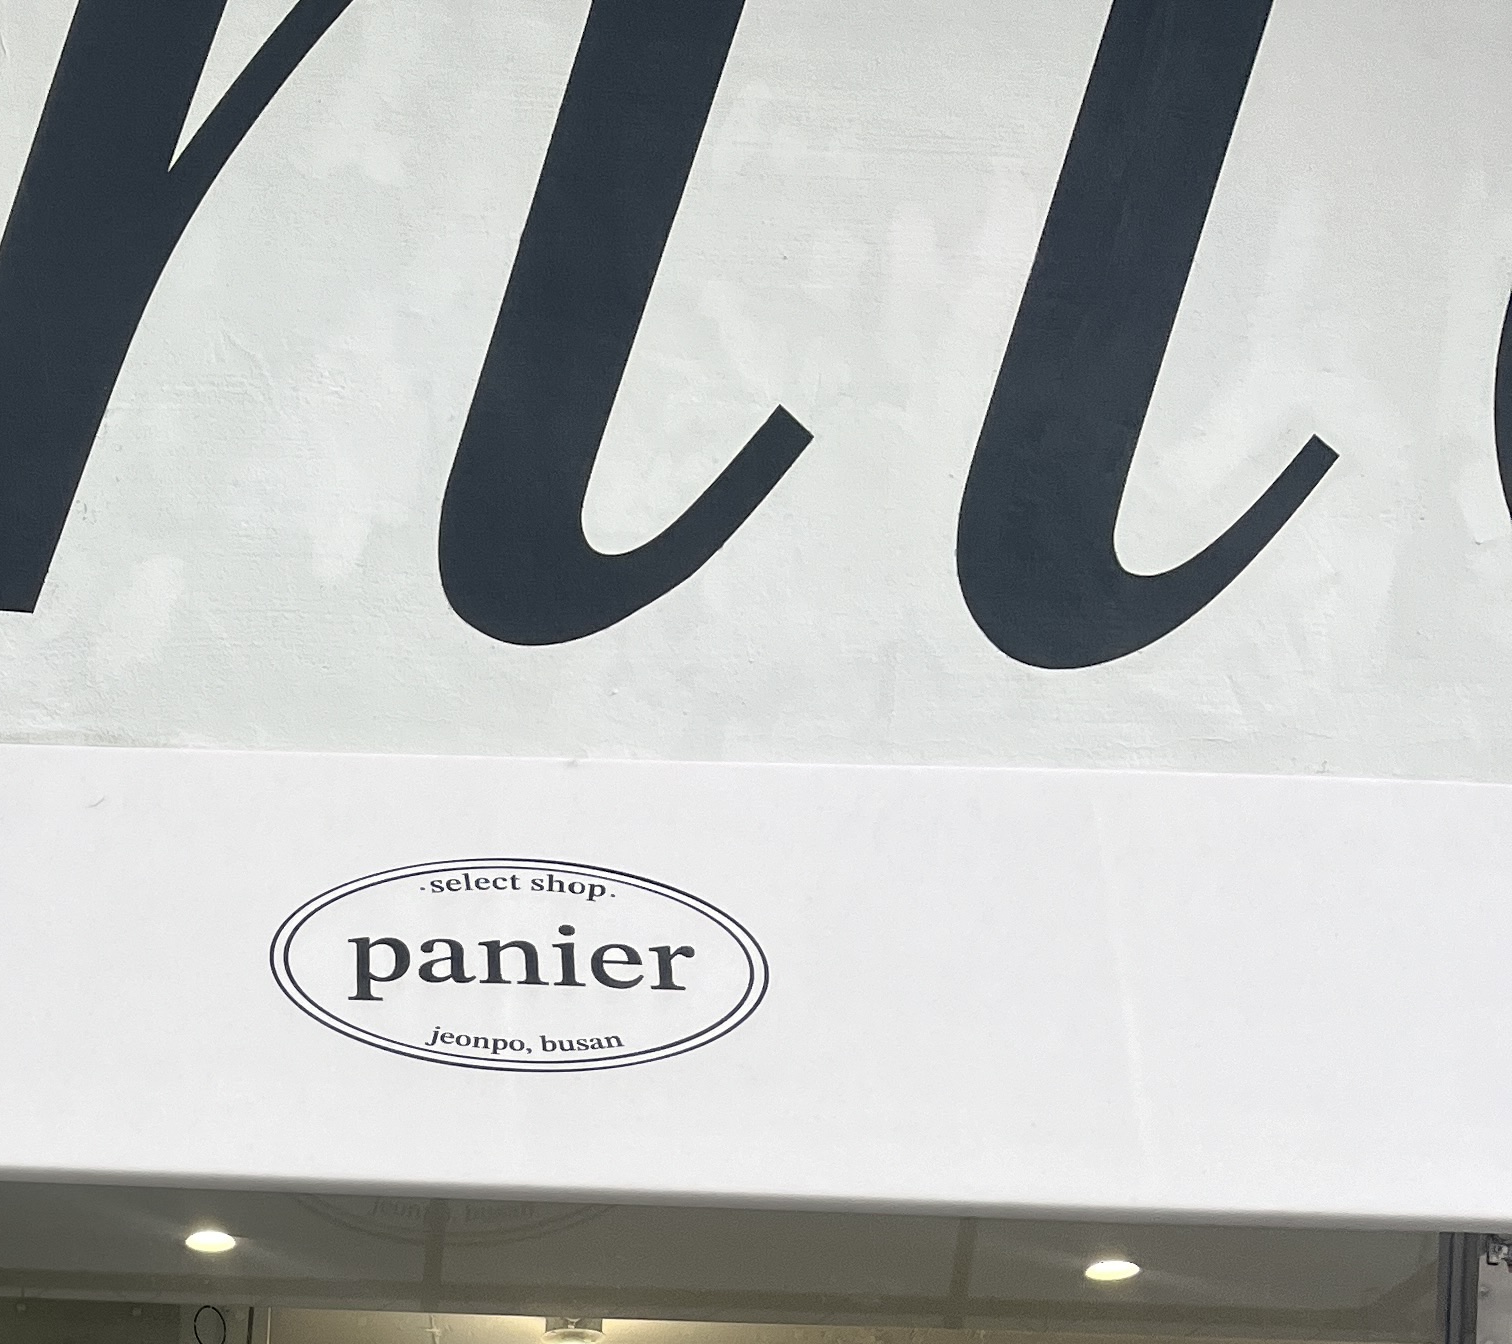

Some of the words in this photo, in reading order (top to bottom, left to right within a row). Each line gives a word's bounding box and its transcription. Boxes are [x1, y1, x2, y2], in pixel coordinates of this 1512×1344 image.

[345, 924, 696, 1002] panier
[424, 1025, 533, 1055] jeonpo,
[539, 1034, 625, 1052] busan
